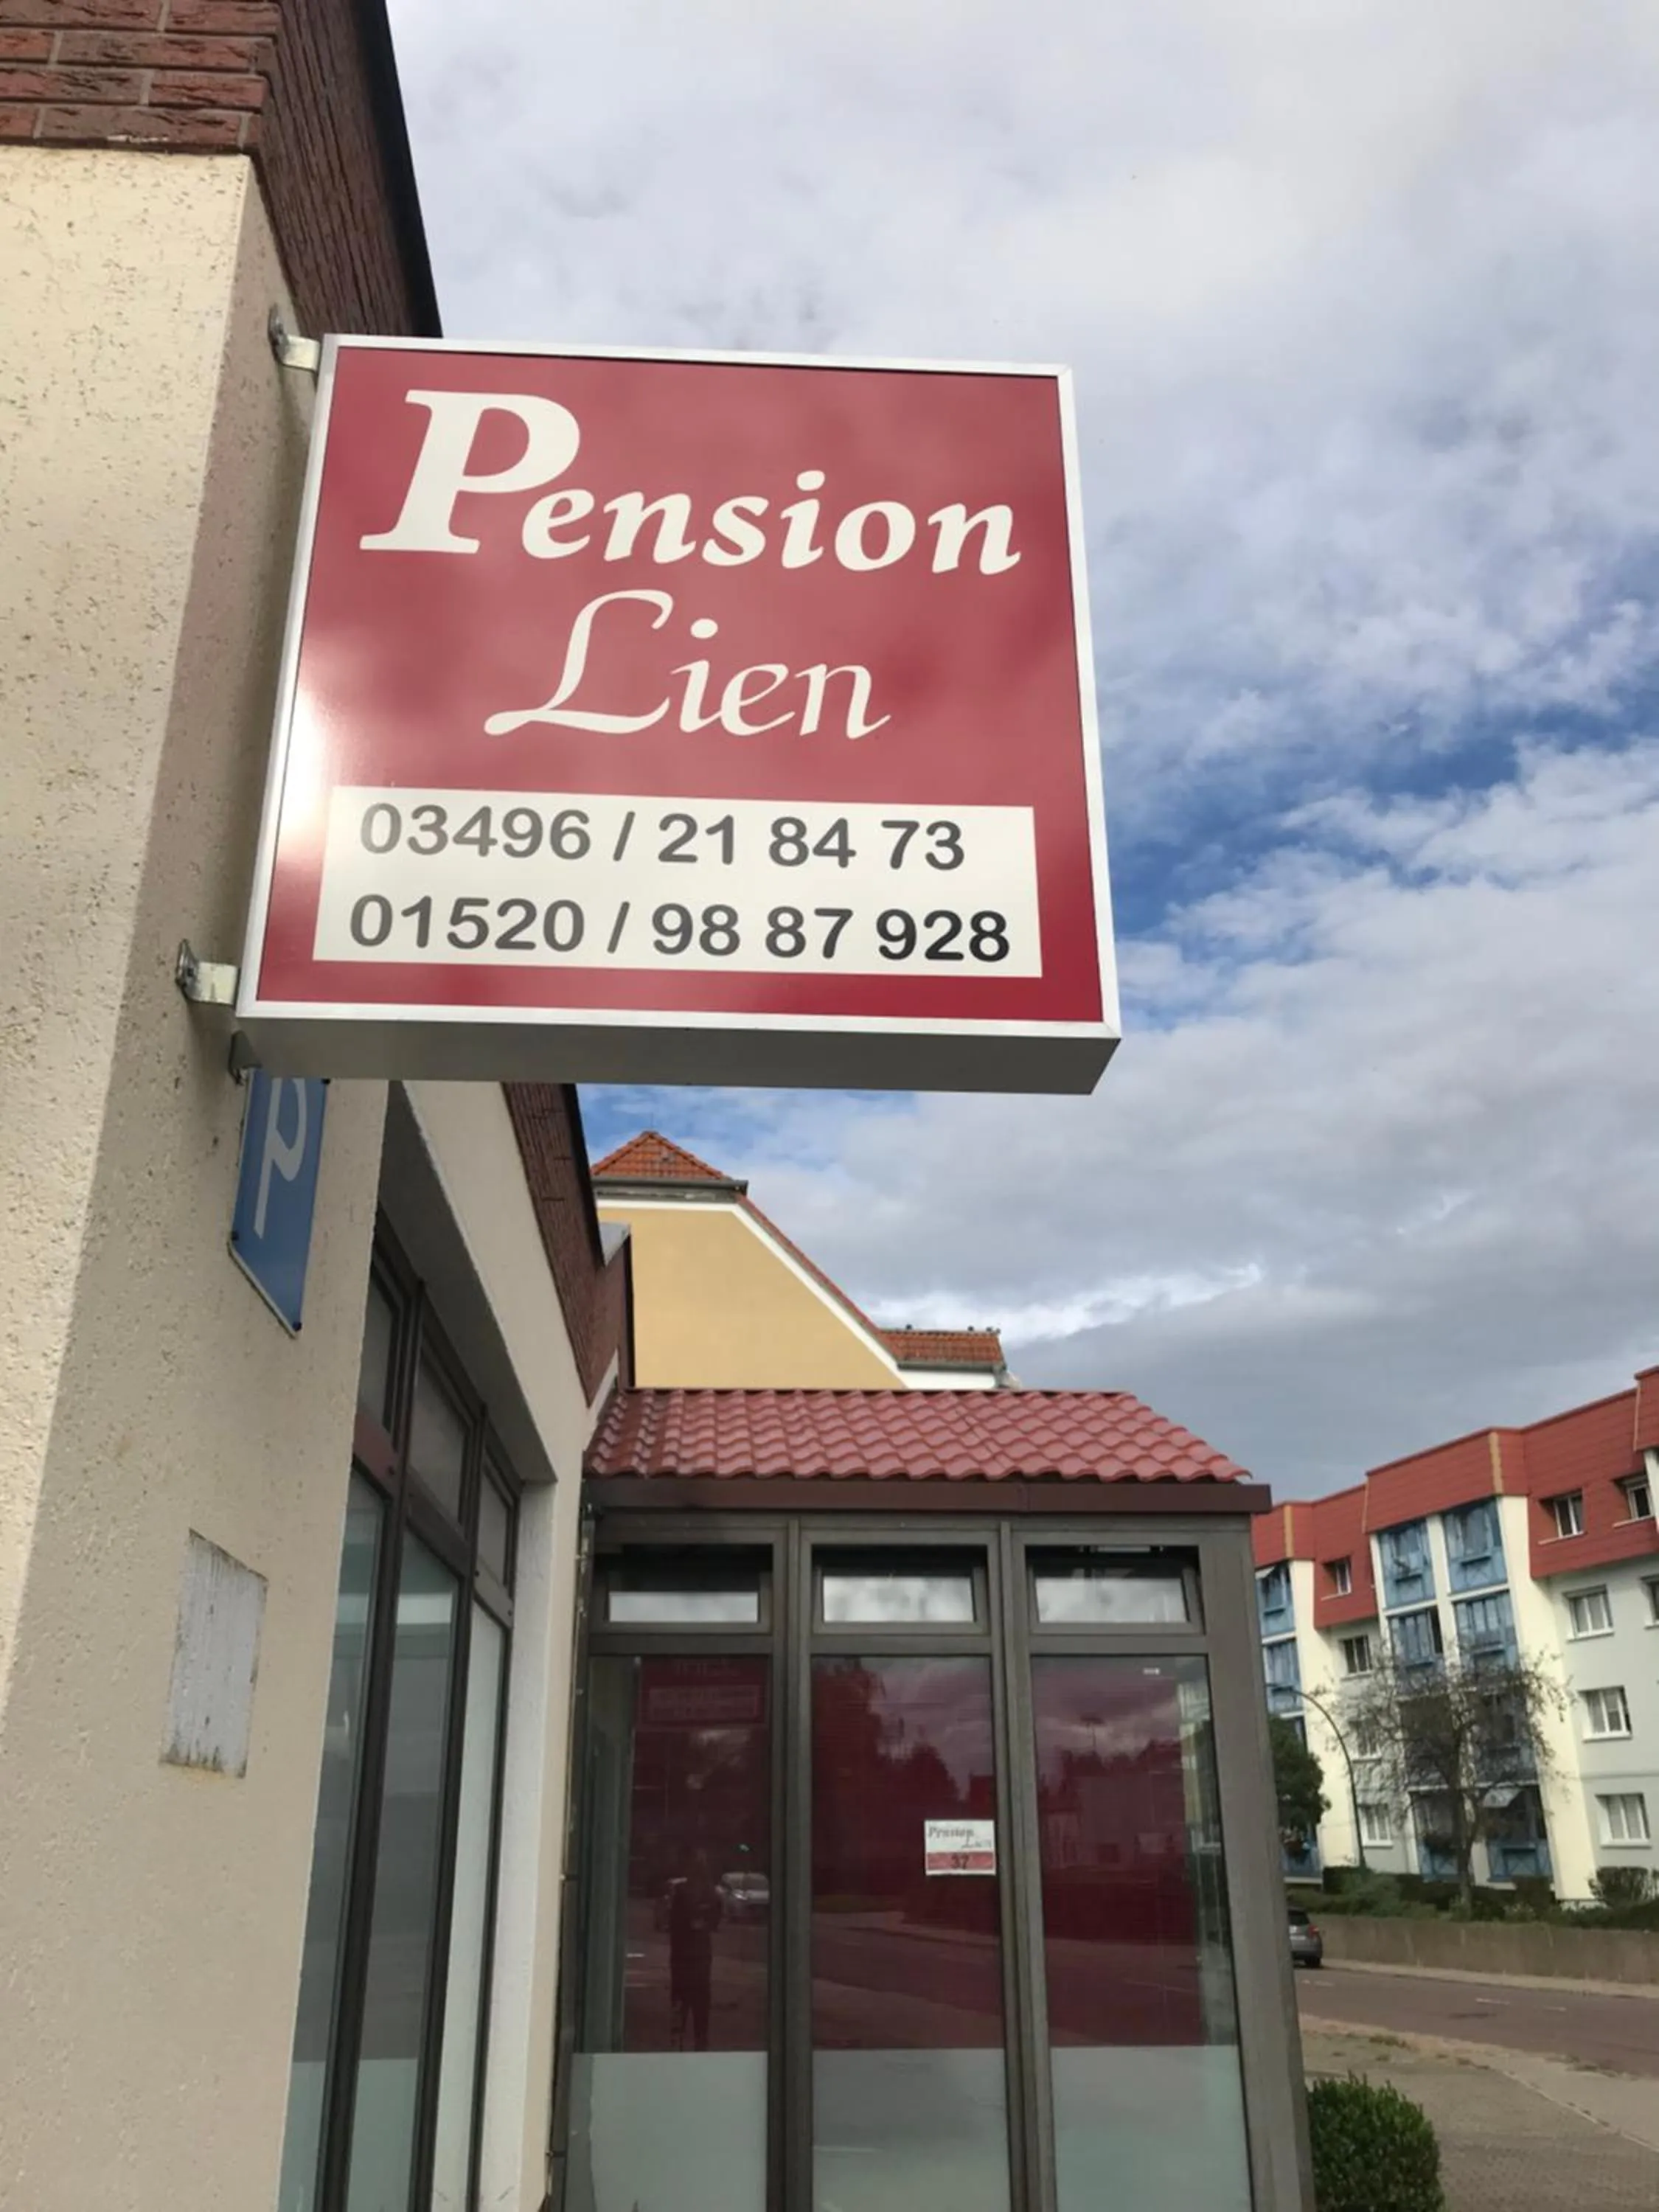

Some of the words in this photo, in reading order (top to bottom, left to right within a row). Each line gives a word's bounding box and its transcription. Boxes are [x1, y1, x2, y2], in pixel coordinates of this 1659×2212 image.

[360, 389, 1021, 575] Pension
[484, 589, 891, 740] Lien
[362, 802, 591, 860] 03496
[613, 810, 636, 862] /
[658, 813, 737, 866] 21
[769, 816, 857, 869] 84
[880, 819, 965, 871] 73
[350, 894, 585, 953] 01520
[607, 900, 630, 954] /
[651, 902, 741, 957] 98
[765, 905, 854, 960] 87
[875, 908, 1011, 963] 928
[254, 1078, 307, 1239] P
